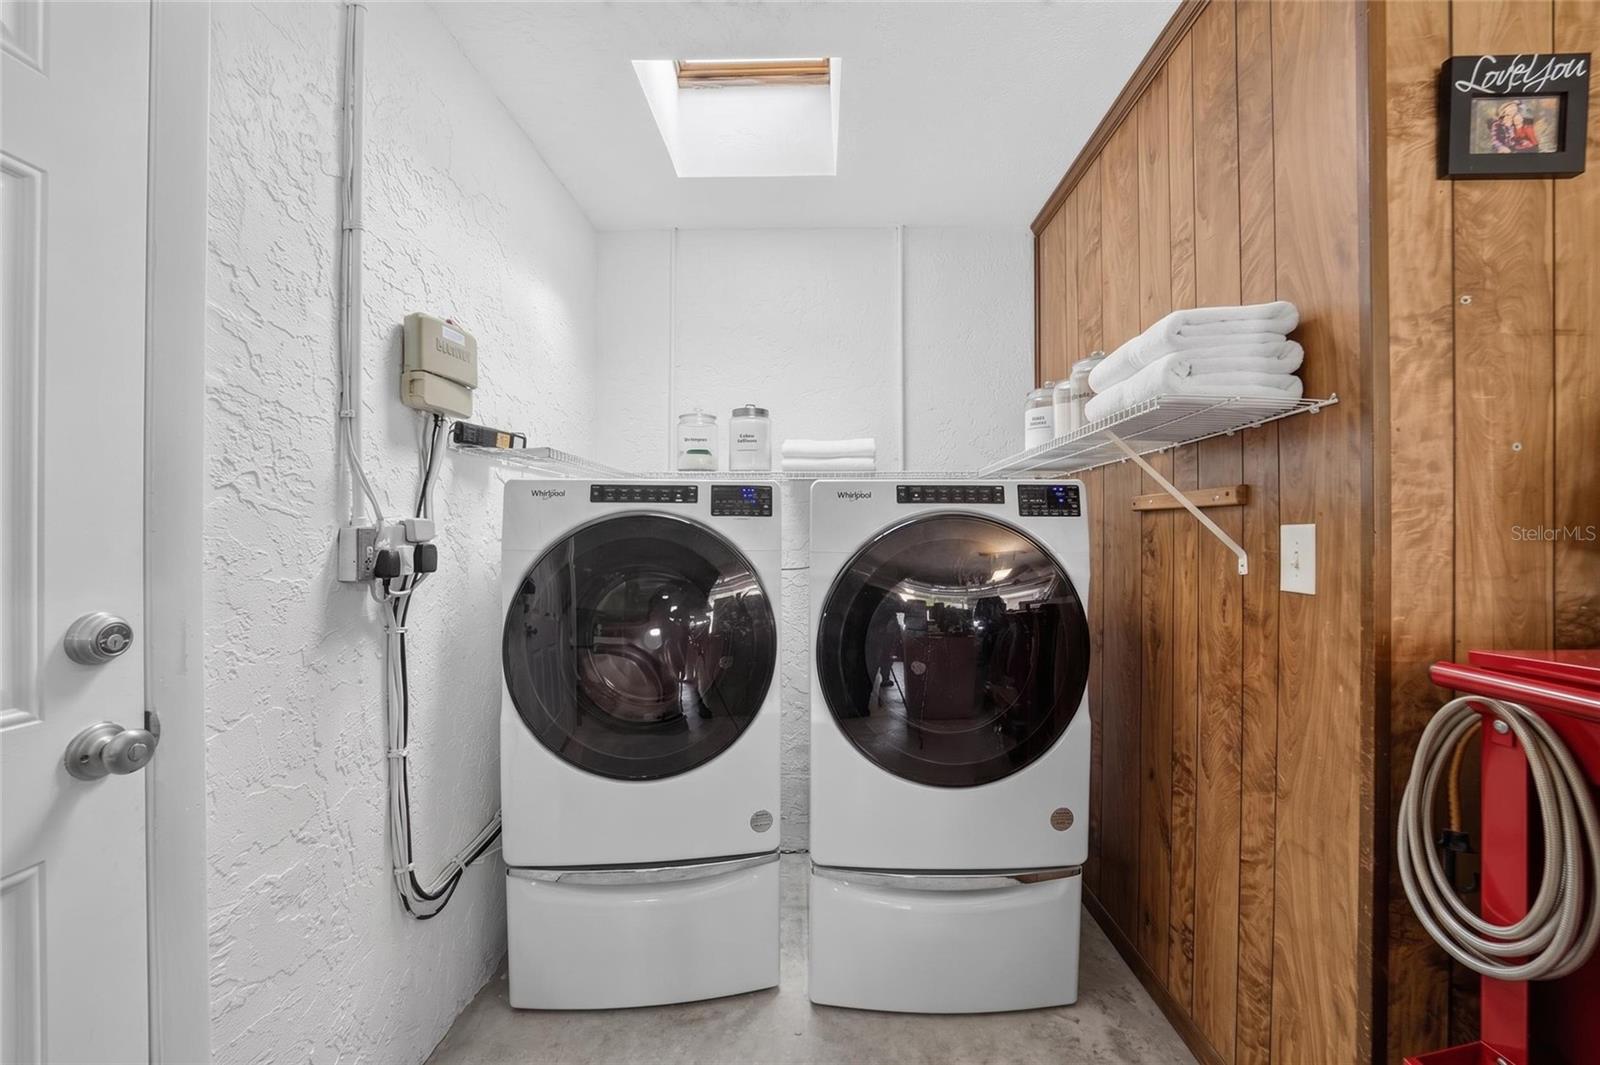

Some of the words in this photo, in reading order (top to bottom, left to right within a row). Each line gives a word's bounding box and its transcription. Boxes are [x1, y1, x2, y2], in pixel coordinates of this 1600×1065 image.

[1455, 54, 1524, 94] Love
[1522, 54, 1586, 93] You
[531, 489, 566, 500] Whirlpool
[837, 491, 872, 501] Whirlpool
